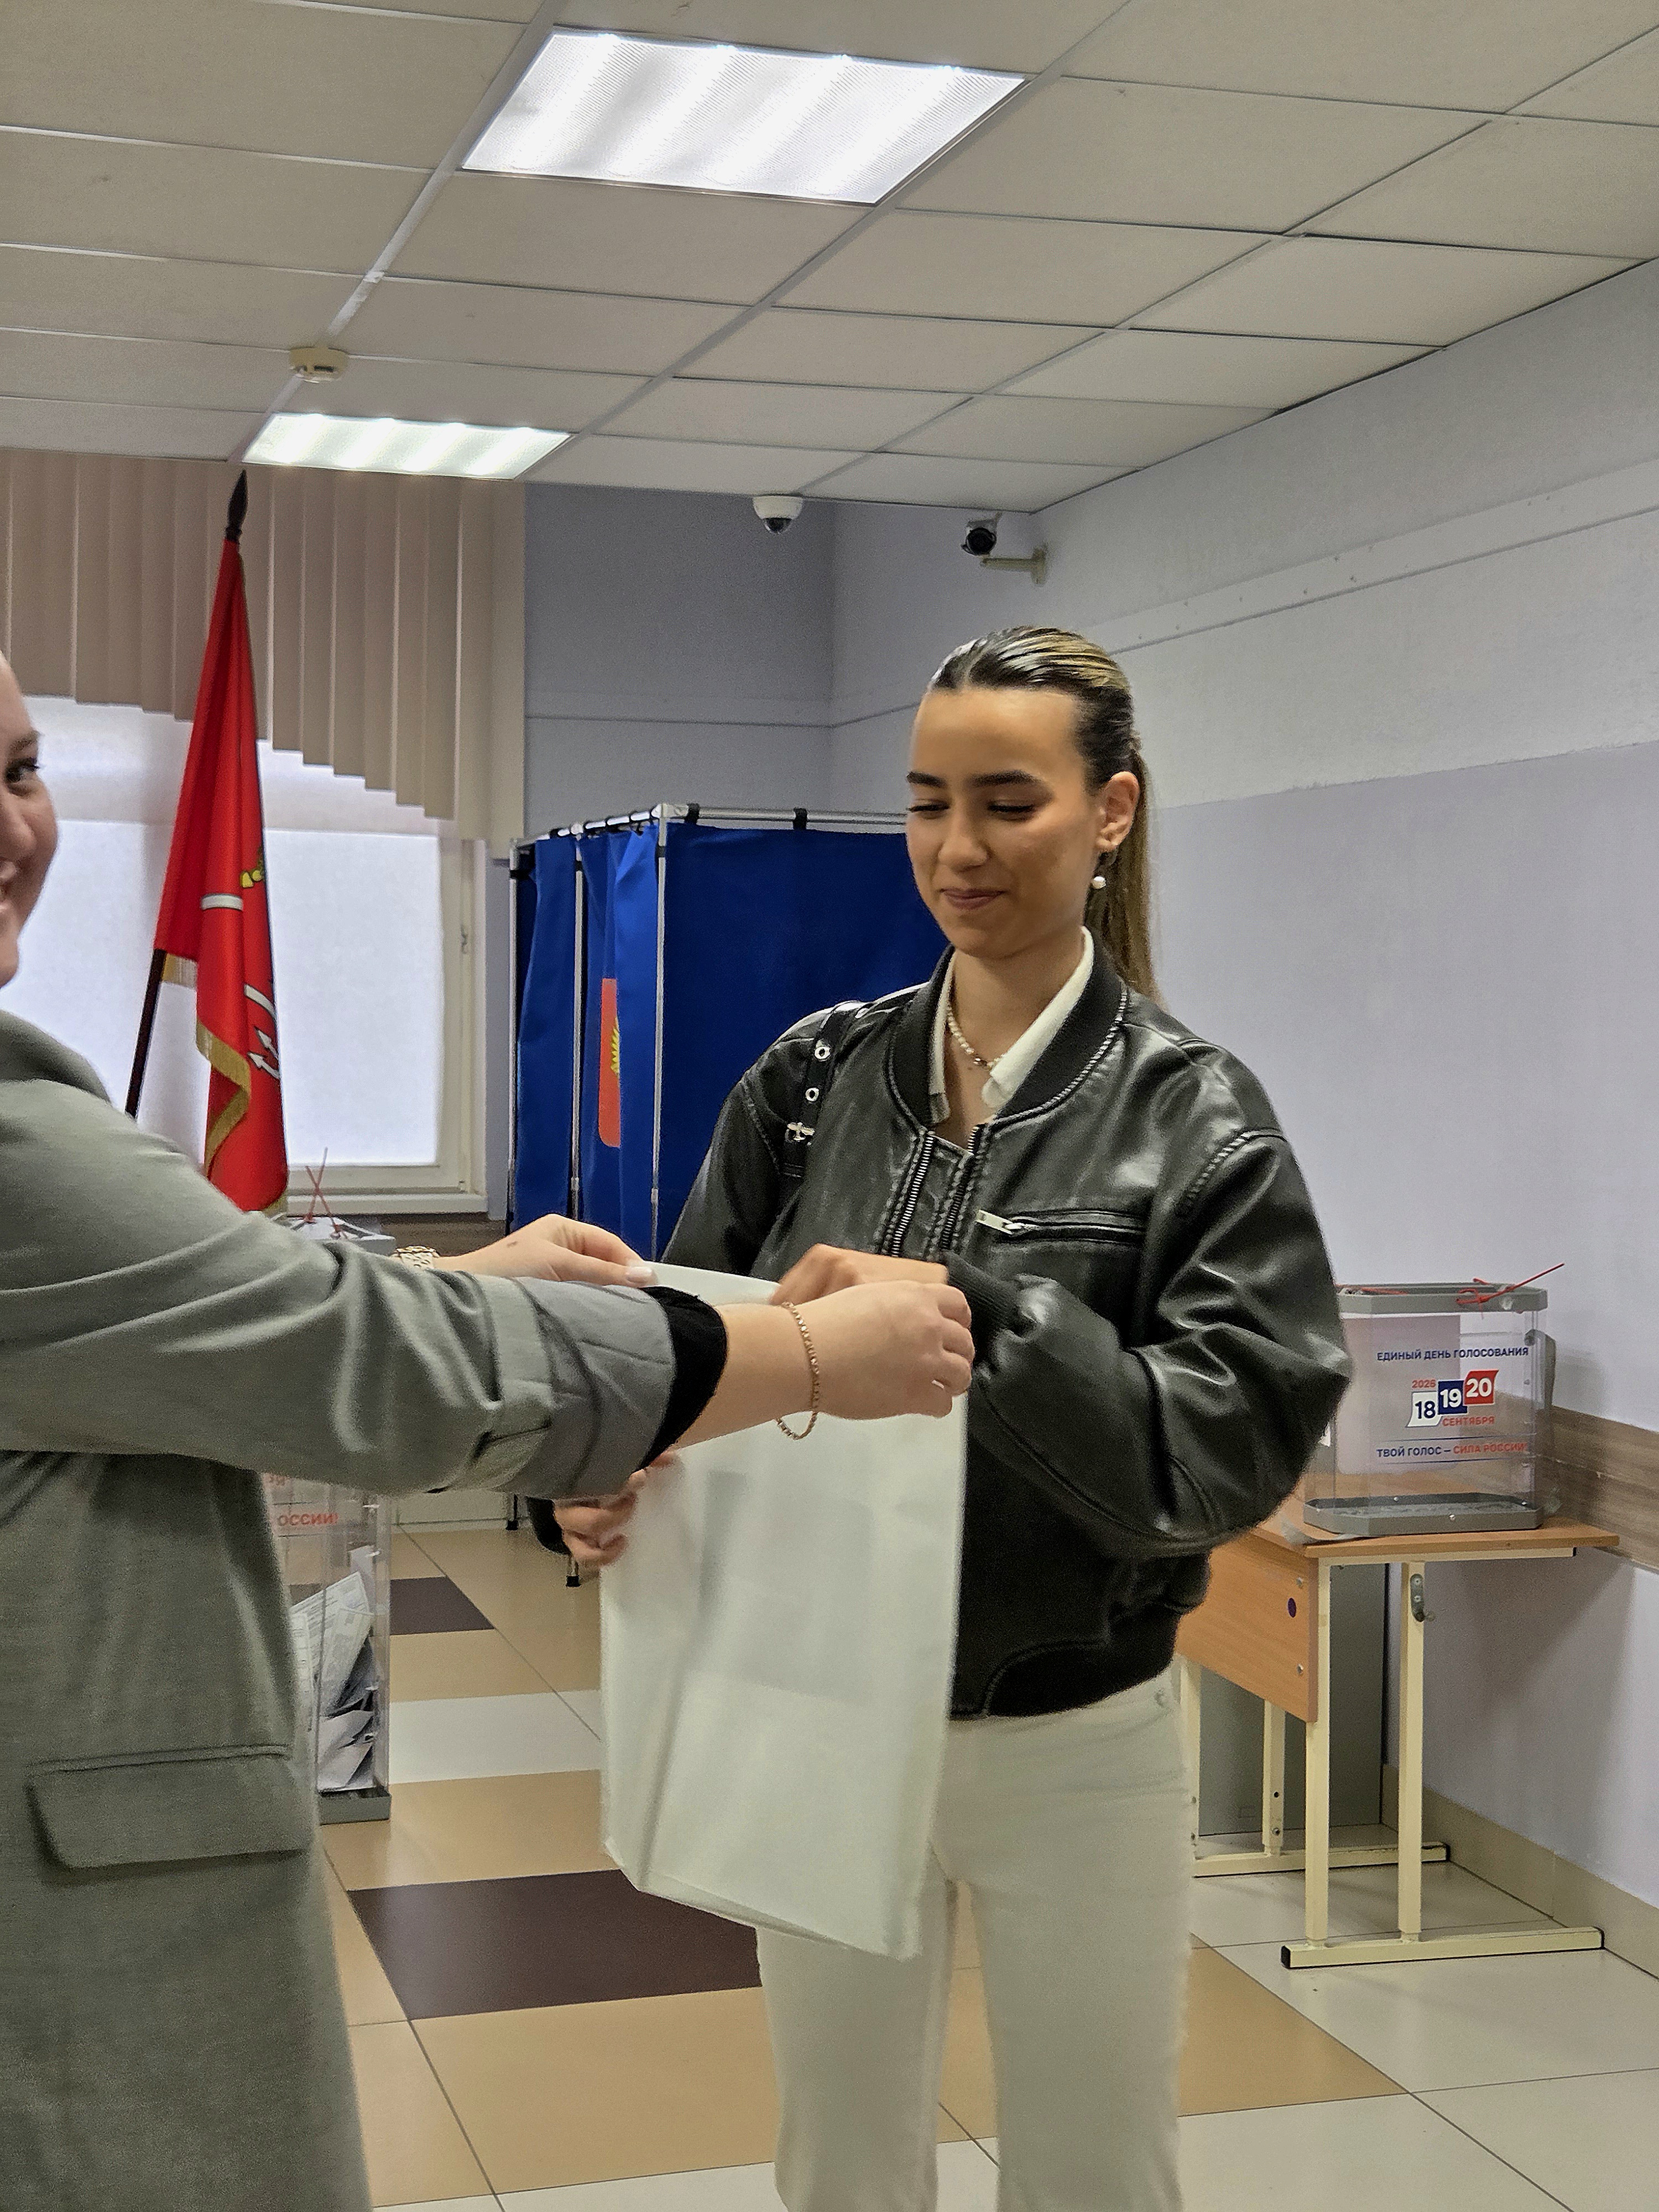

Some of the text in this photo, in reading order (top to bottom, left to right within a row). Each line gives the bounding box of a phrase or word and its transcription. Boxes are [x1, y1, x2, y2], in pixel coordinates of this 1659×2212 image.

[1377, 1347, 1529, 1361] ЕДИНЫЙ ДЕНЬ ГОЛОСОВАНИЯ
[1412, 1379, 1436, 1389] 2026
[1415, 1378, 1493, 1419] 18 19 20
[1442, 1416, 1495, 1427] СЕНТЯБРЯ
[1376, 1446, 1405, 1458] ТВОЙ
[1407, 1446, 1442, 1457] ГОЛОС
[1453, 1444, 1480, 1454] СИЛА
